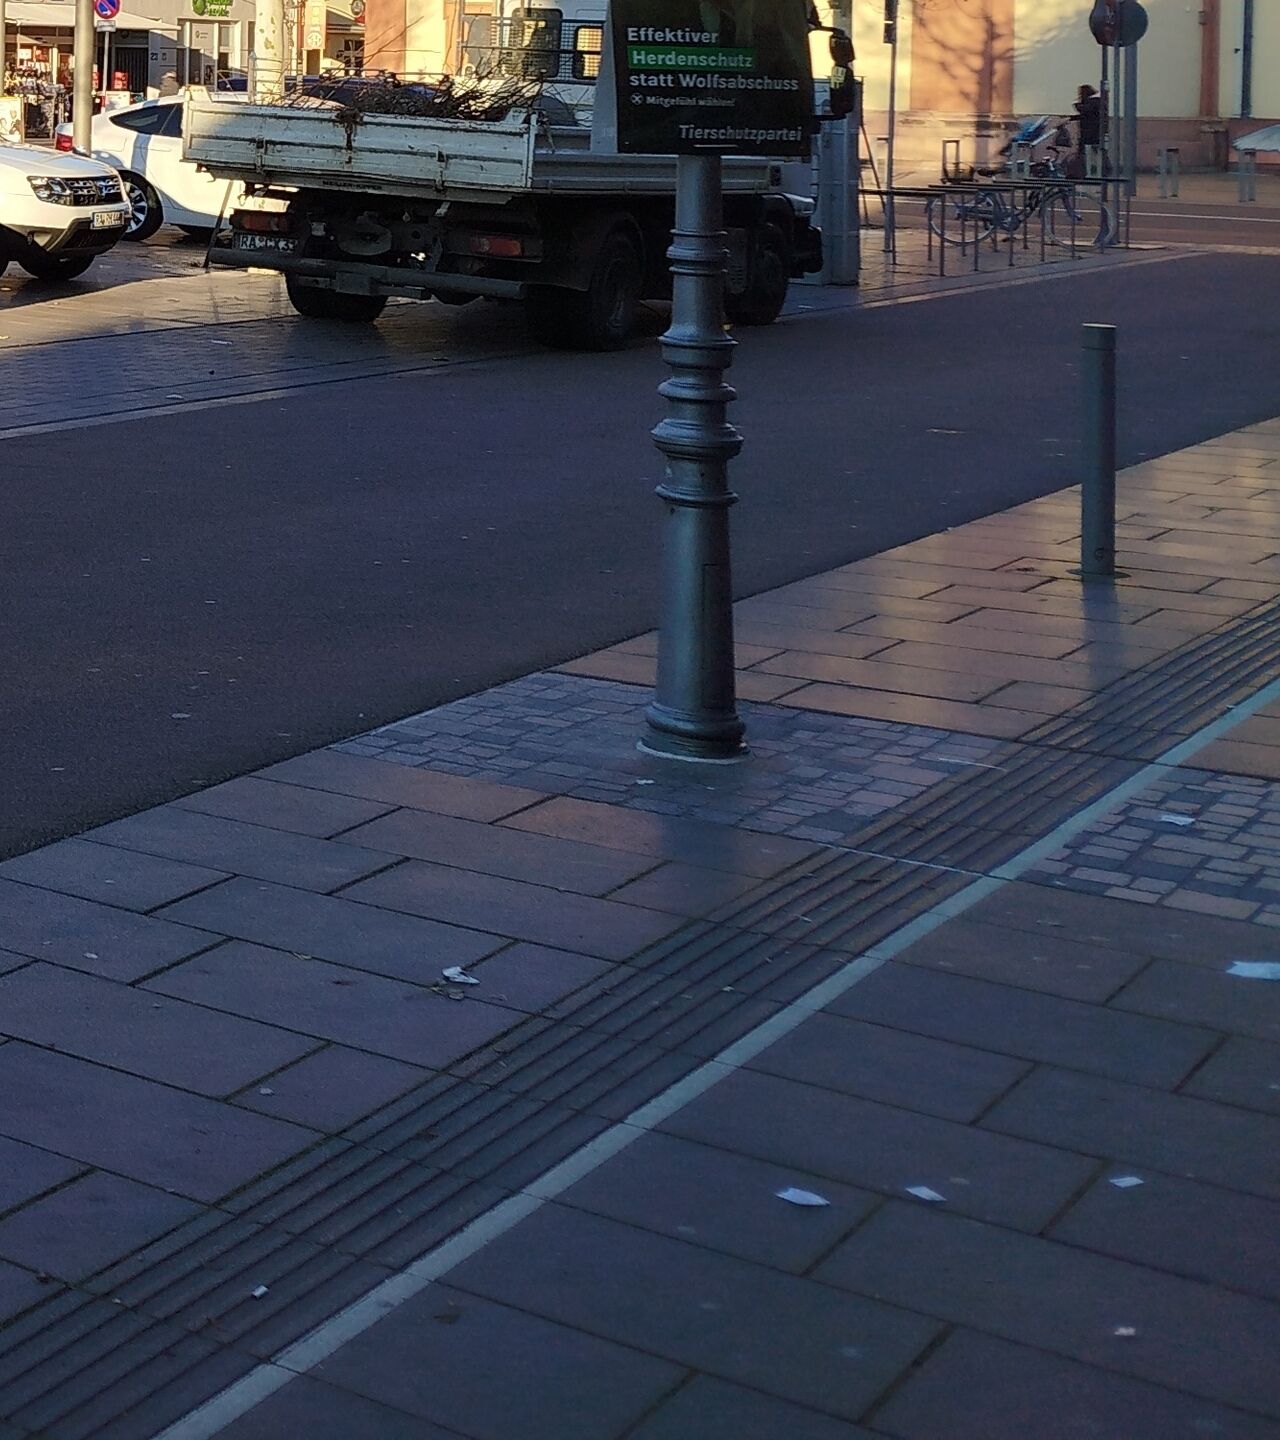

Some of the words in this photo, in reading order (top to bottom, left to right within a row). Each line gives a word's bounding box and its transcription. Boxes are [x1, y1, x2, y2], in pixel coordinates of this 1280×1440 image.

[626, 26, 719, 43] Effektiver
[632, 50, 753, 68] Herdenschutz
[629, 73, 675, 87] statt
[679, 73, 799, 91] Wolfsabschuss
[679, 124, 802, 144] Tierschutzpartei
